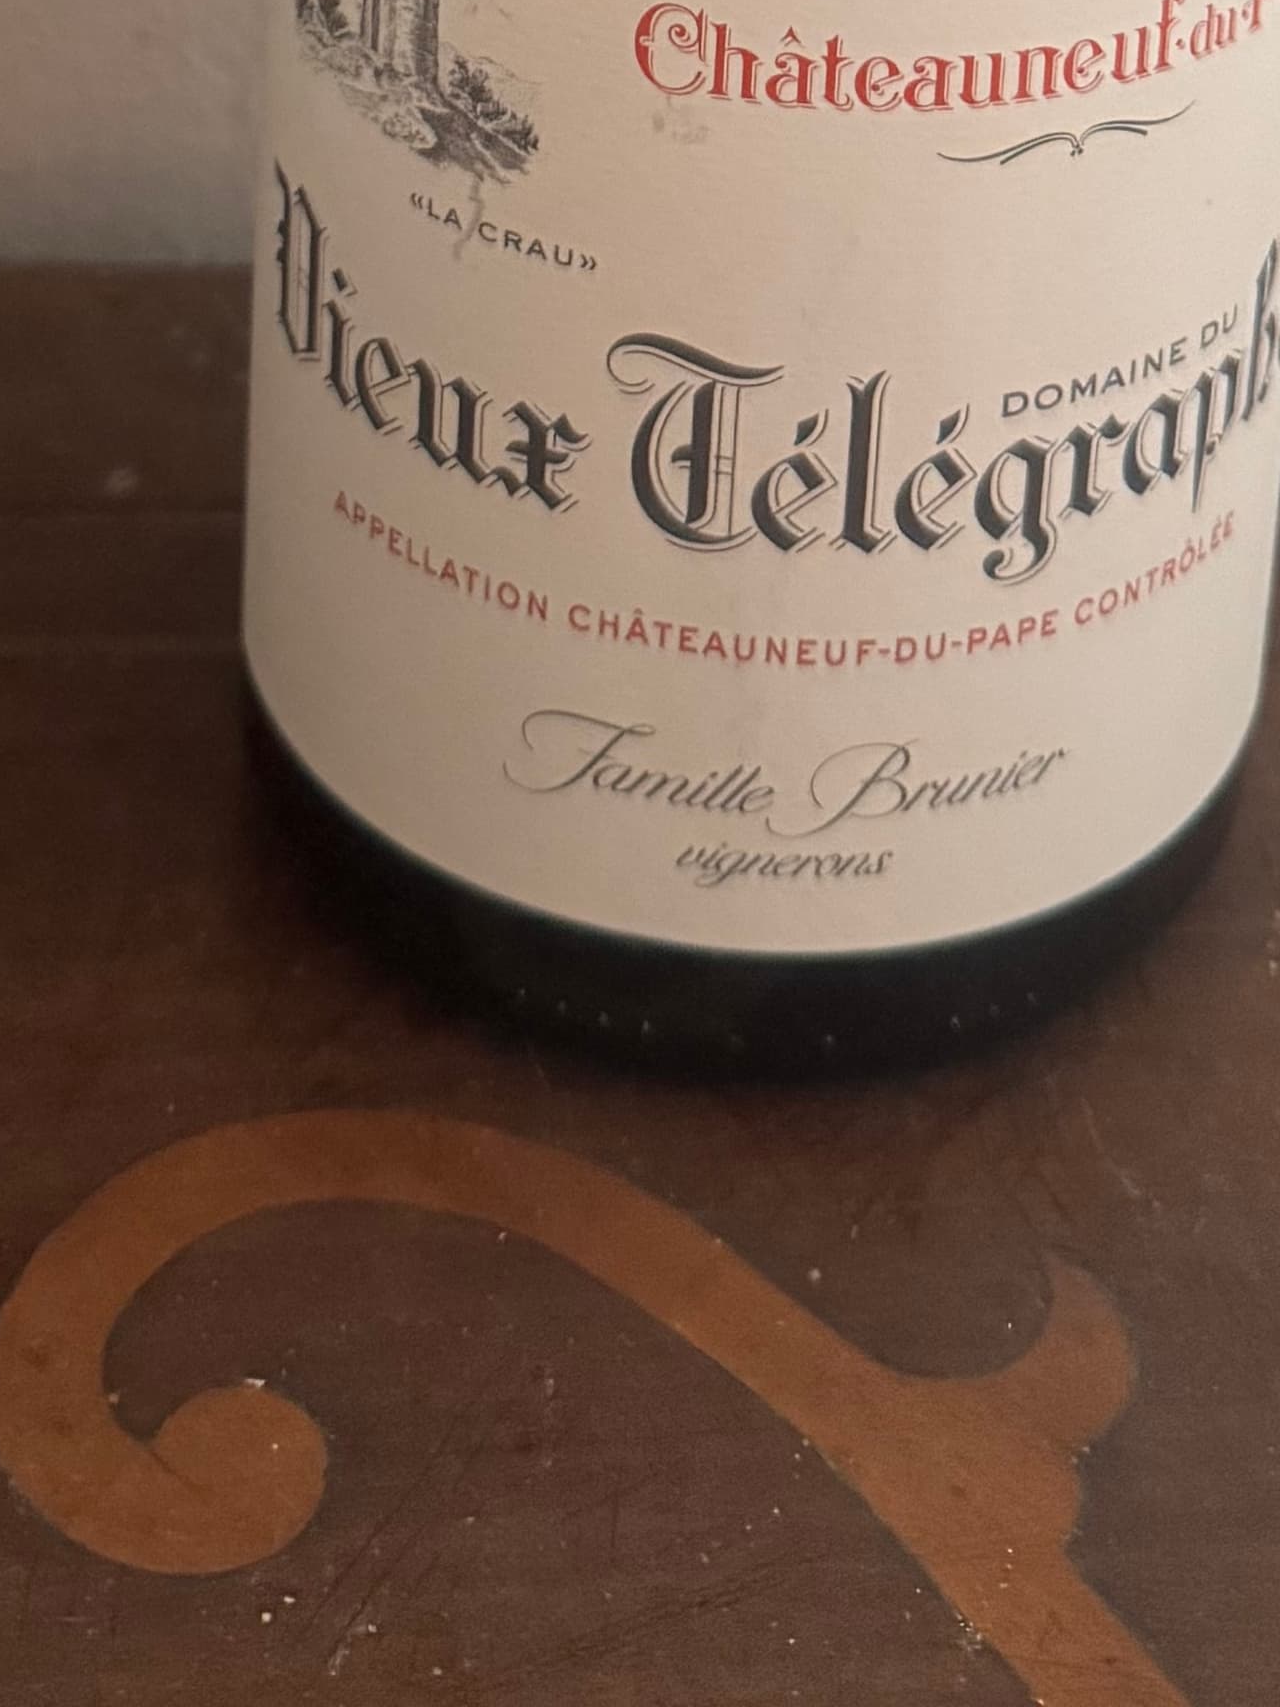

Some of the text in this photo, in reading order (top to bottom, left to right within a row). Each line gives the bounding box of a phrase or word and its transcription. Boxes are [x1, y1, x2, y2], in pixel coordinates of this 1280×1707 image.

[478, 221, 598, 272] CRAU»
[274, 156, 592, 513] Vieux
[1001, 303, 1240, 419] DOMAINE DU
[333, 490, 1237, 669] APPELLATION CHÂTEAUNEUF-DU-PAPE CONTRÔLÉE
[503, 709, 1072, 838] Famille Brunier
[675, 841, 896, 886] vignerons
